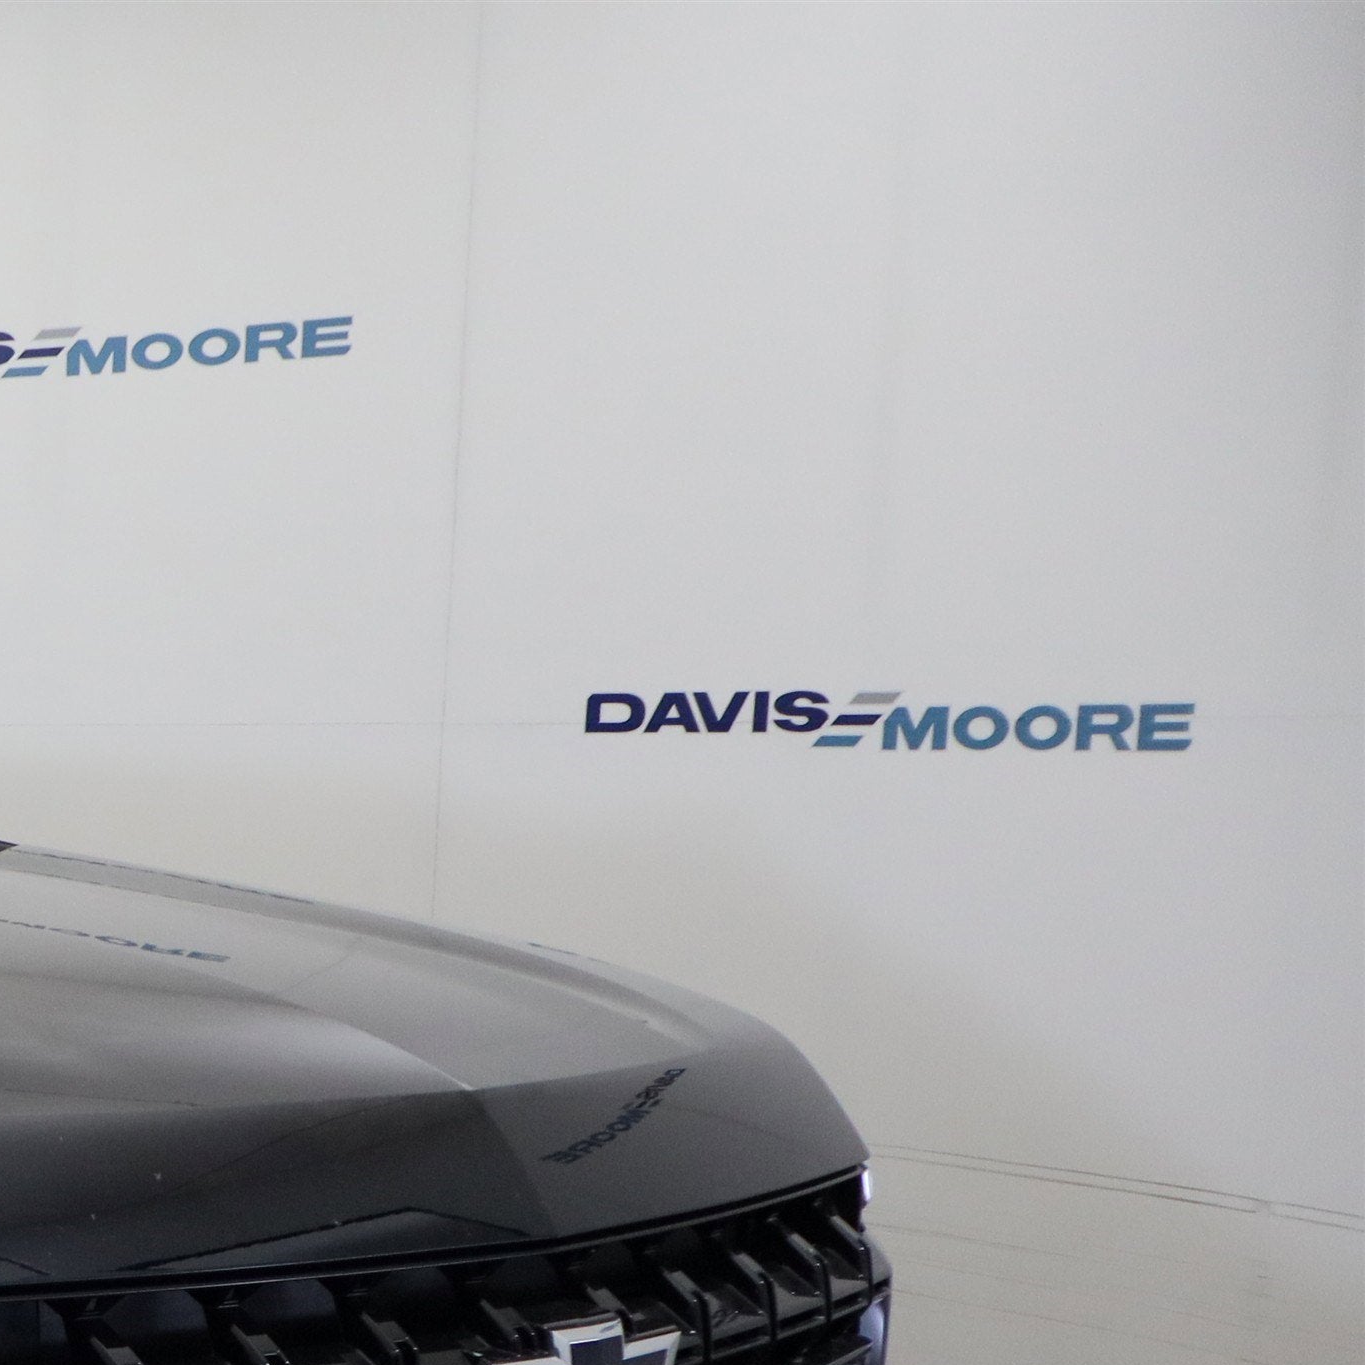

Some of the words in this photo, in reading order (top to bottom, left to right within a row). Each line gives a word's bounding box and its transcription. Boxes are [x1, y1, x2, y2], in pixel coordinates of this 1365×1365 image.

[66, 316, 354, 378] MOORE
[584, 690, 830, 734] DAVIS
[881, 703, 1196, 752] MOORE
